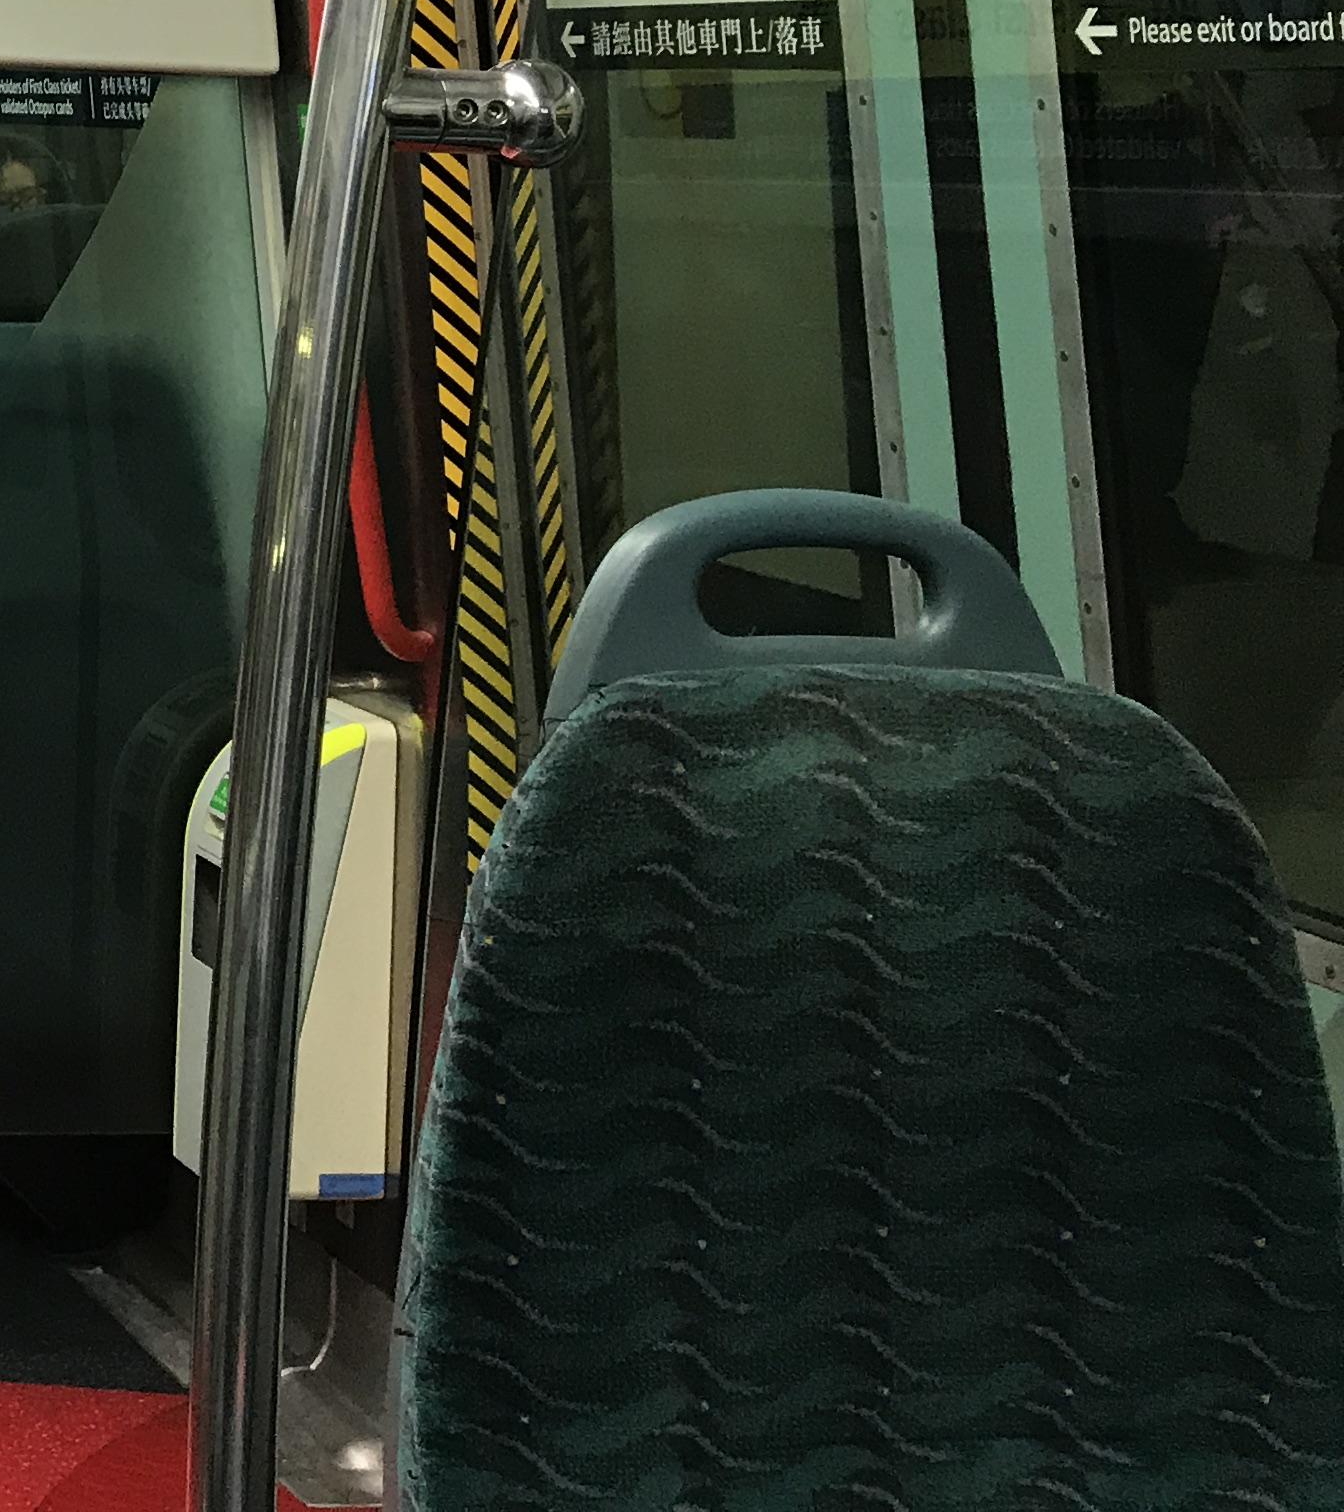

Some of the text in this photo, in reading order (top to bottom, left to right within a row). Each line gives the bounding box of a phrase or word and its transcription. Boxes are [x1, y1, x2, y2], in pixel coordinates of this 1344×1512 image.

[590, 16, 824, 57] 請經由其他車門上/落車
[1128, 12, 1334, 44] Please exit or board
